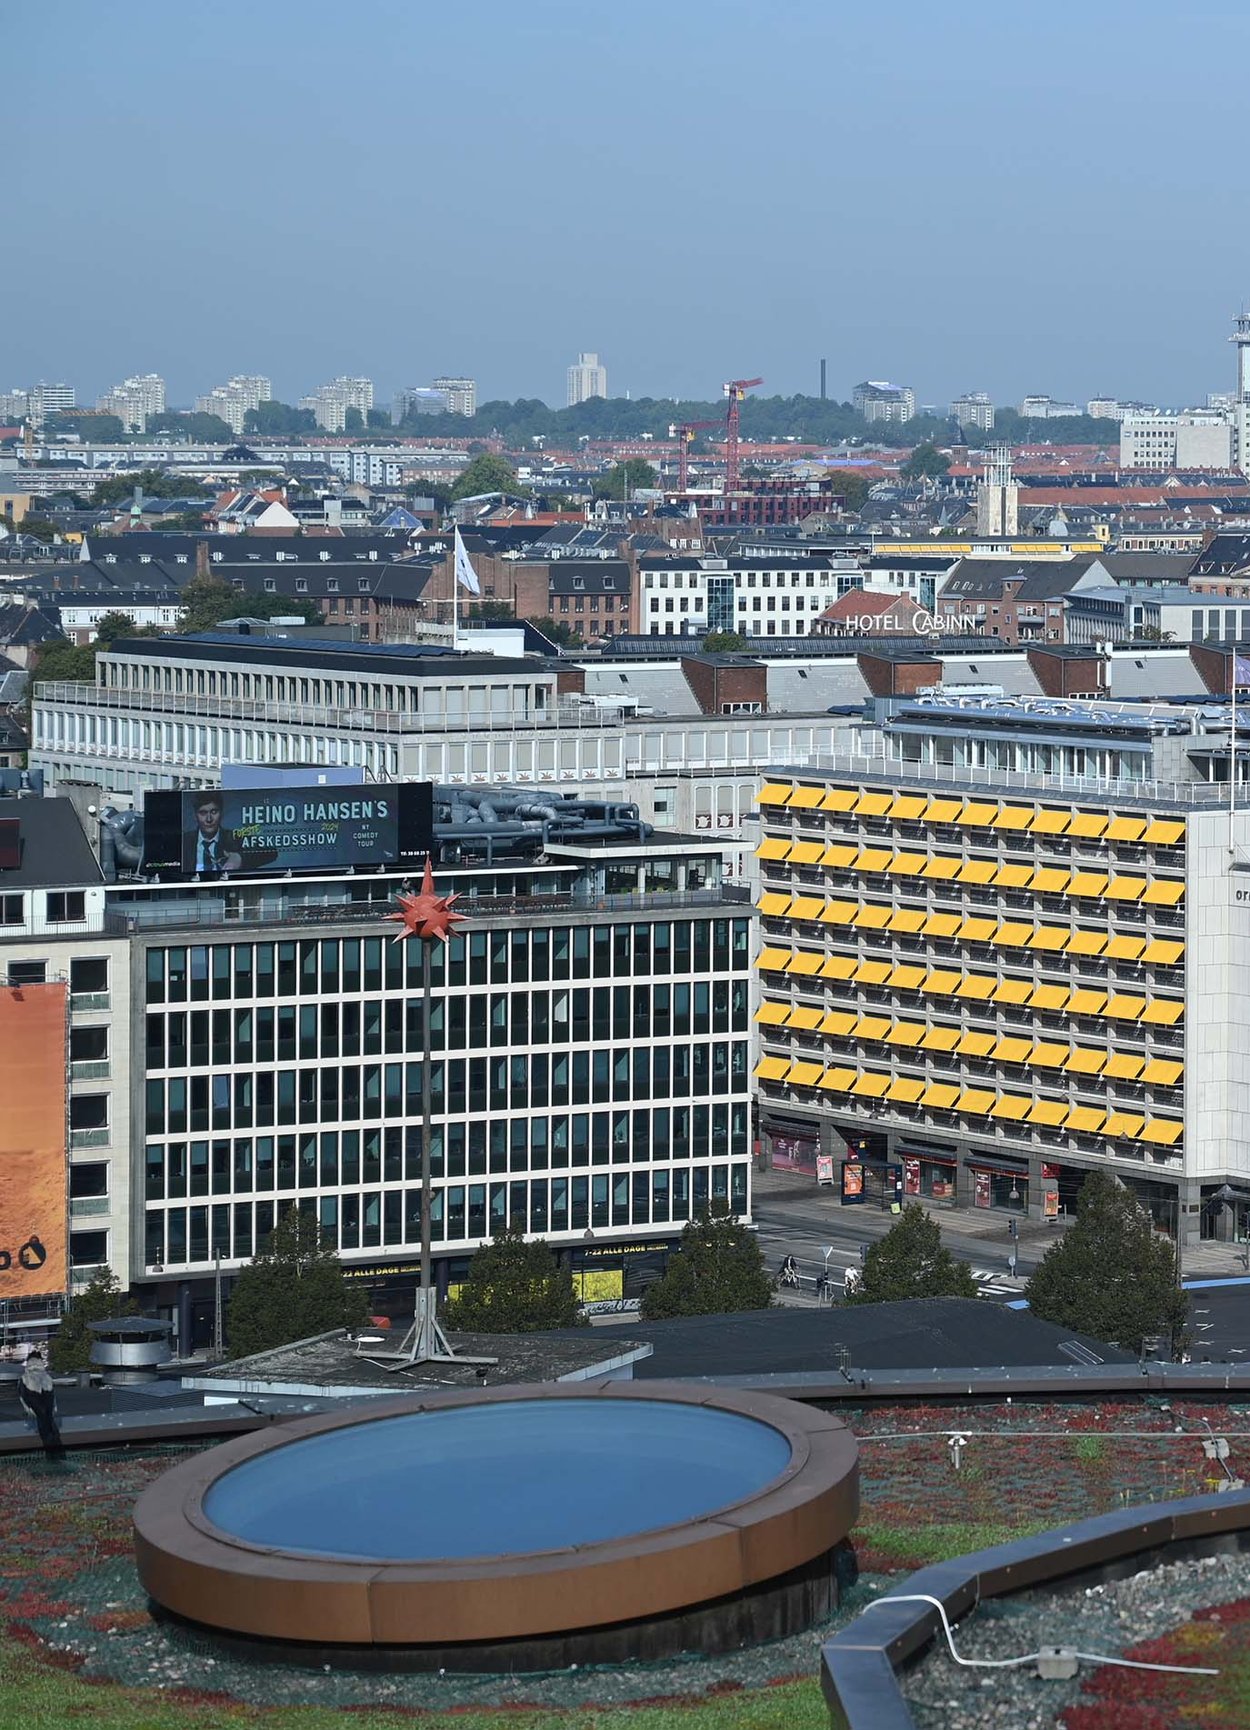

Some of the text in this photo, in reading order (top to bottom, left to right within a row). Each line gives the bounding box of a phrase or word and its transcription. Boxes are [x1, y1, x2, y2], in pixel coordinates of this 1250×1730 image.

[846, 611, 976, 634] HOTEL CABINN
[242, 805, 296, 824] HEINO
[242, 833, 337, 848] AFSKEDSSHOW
[602, 1247, 623, 1255] ALLE
[623, 1245, 646, 1253] DAGE
[354, 1269, 374, 1277] ALLE
[375, 1267, 399, 1275] DAGE
